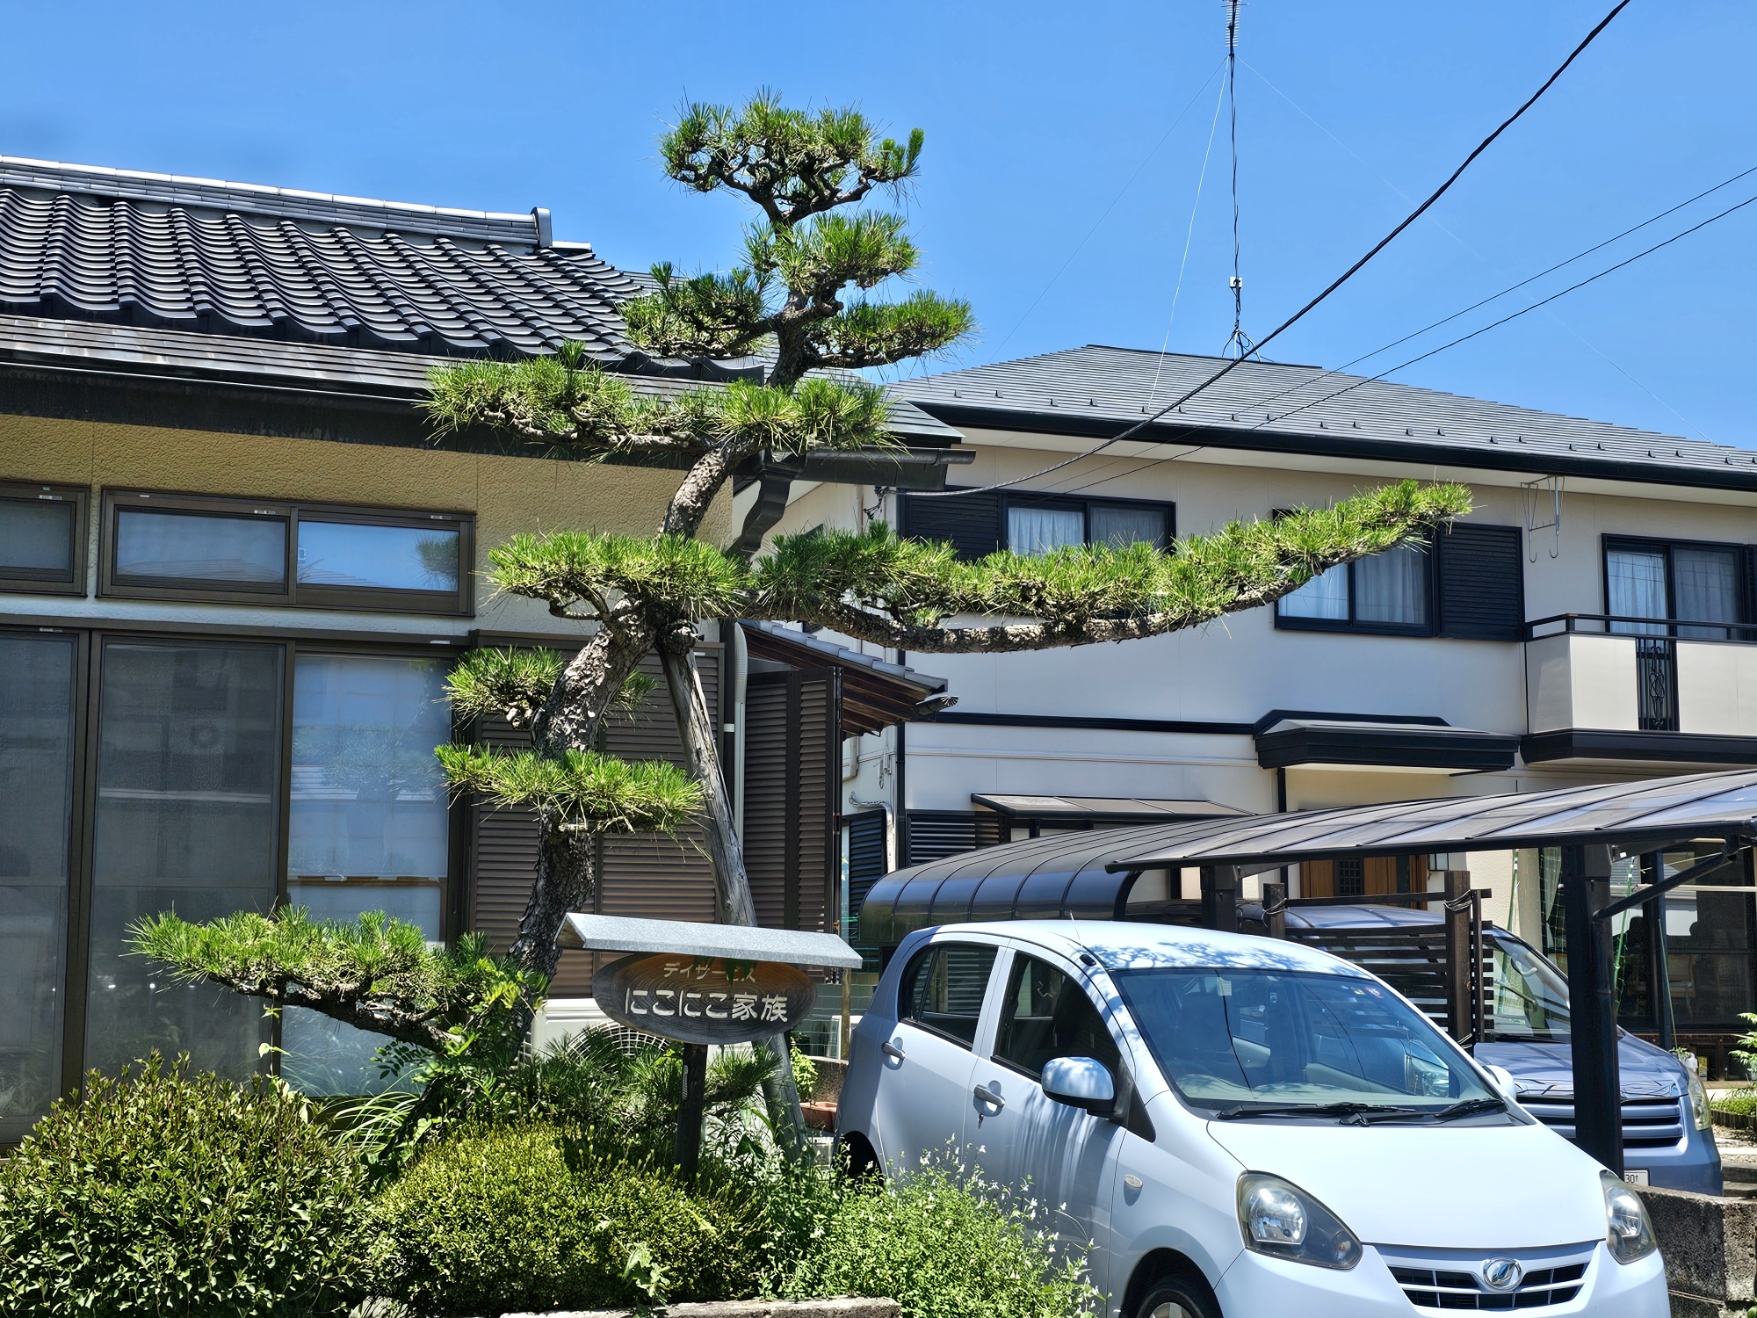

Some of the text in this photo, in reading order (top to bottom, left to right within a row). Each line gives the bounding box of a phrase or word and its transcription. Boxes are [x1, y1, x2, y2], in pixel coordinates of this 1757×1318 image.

[624, 987, 788, 1022] にこにこ家族
